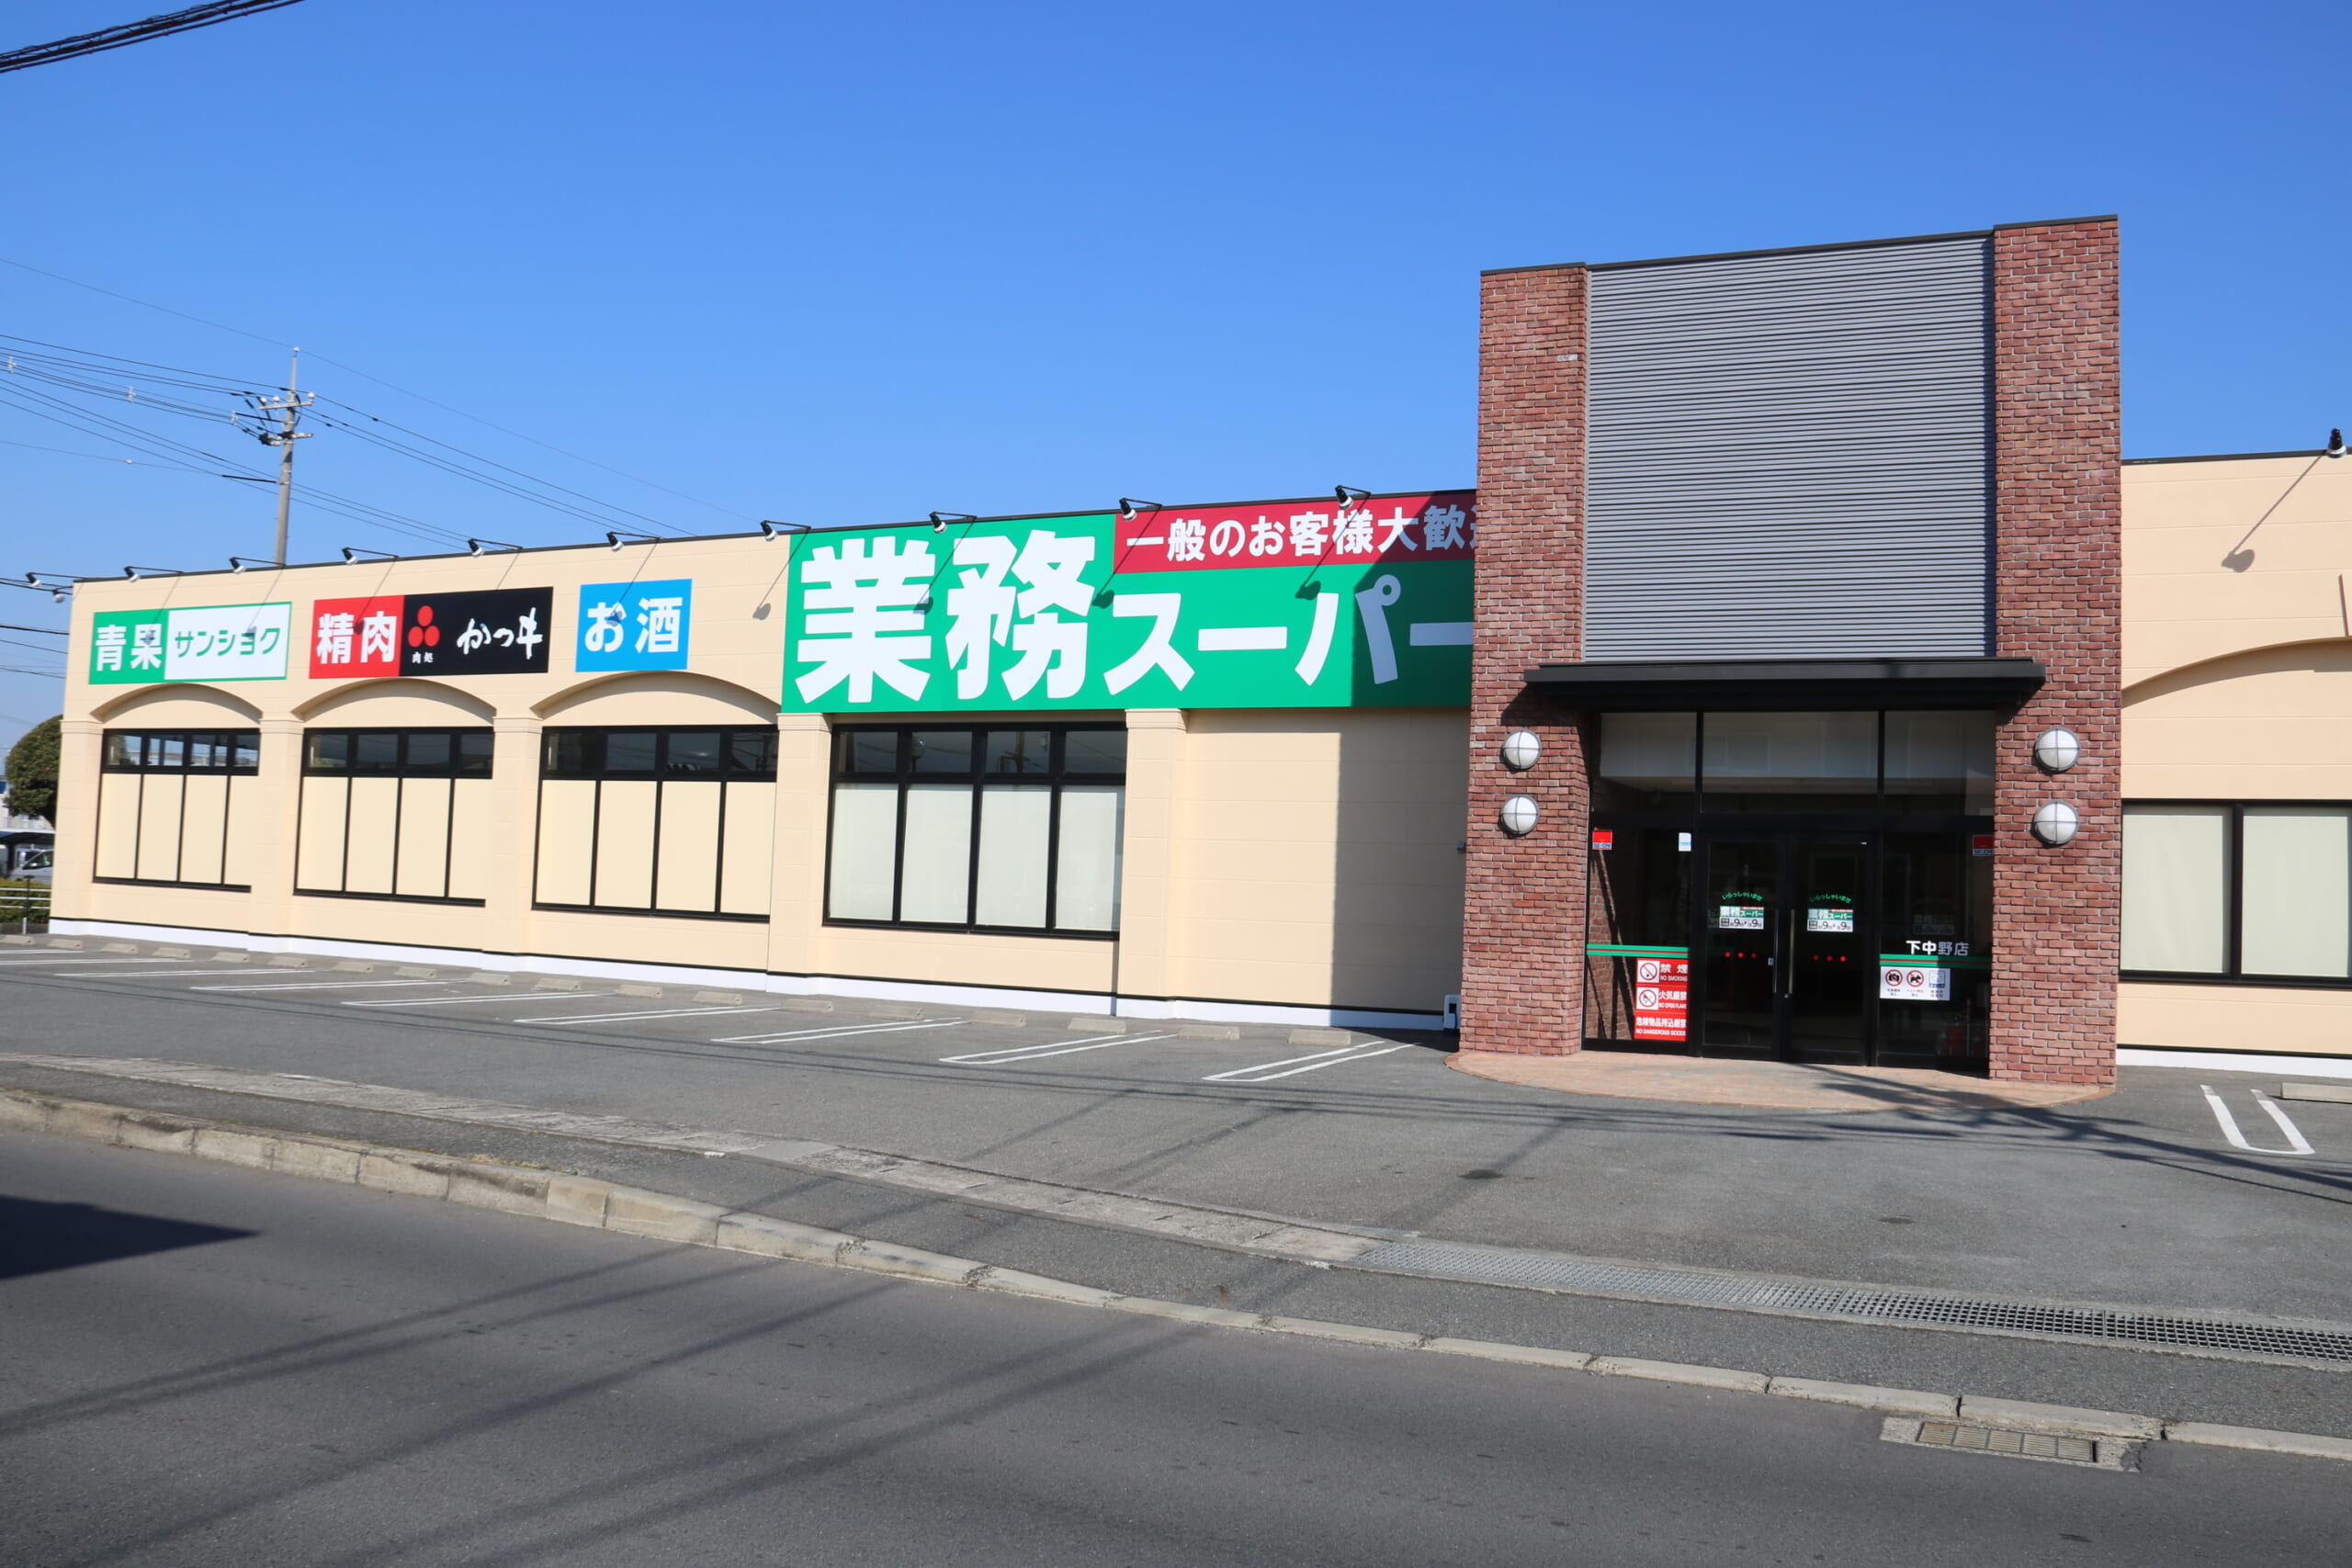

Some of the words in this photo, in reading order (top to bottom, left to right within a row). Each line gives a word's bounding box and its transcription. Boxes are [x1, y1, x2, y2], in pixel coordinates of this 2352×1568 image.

[1126, 504, 1477, 562] 一般のお客様大歓
[315, 610, 398, 665] 精肉
[584, 597, 683, 654] お酒
[794, 529, 1474, 705] 業務スーパー
[95, 623, 164, 672] 青果
[174, 627, 281, 658] サンショク
[1660, 964, 1689, 974] 禁煙
[1905, 940, 1969, 955] 下中野店
[1659, 990, 1687, 1000] 火気厳禁
